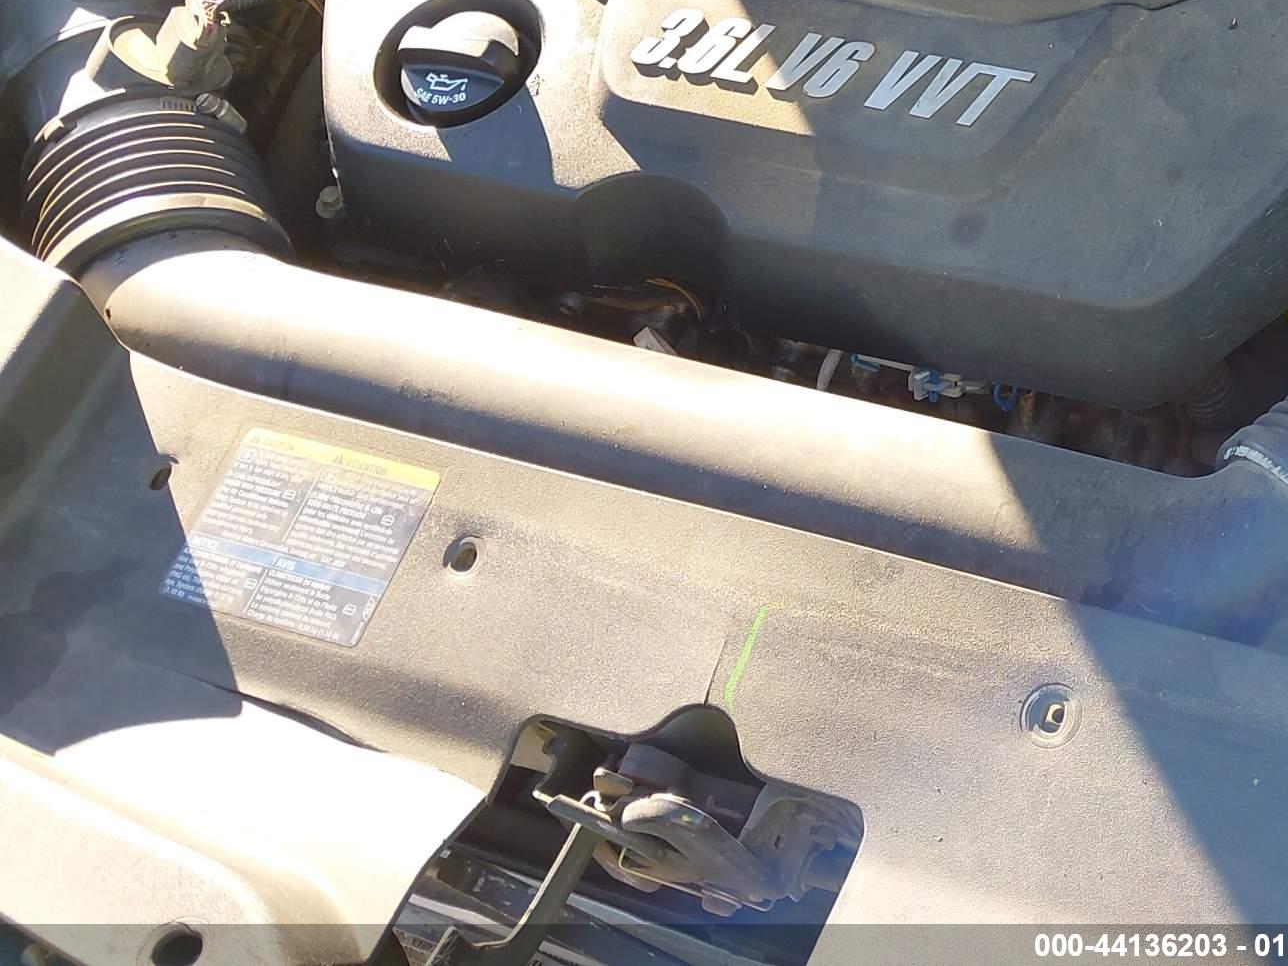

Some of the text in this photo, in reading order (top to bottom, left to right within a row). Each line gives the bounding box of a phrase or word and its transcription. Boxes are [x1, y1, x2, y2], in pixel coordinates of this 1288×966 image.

[630, 9, 1037, 127] 3.6L V6 VVT
[416, 88, 467, 105] SAE 5W-30
[277, 556, 296, 571] AVIS
